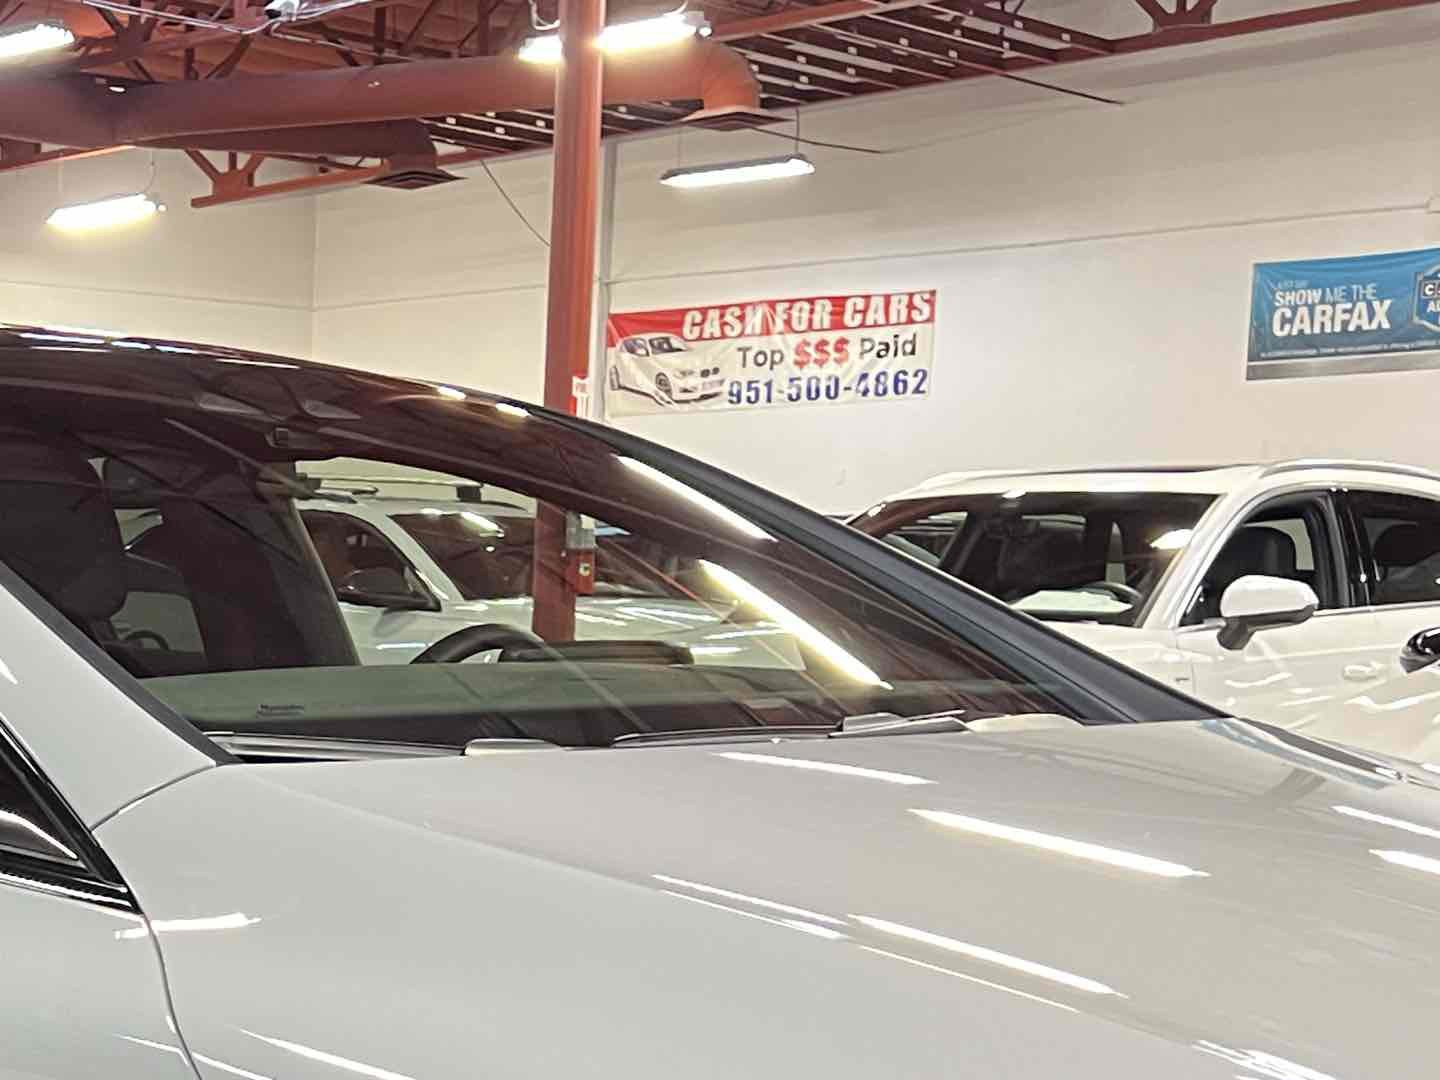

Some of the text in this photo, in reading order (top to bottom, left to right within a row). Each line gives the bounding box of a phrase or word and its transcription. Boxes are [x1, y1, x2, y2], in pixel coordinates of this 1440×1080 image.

[1273, 283, 1377, 307] SHOW ME THE
[682, 292, 932, 341] CASH FOR CARS
[1271, 299, 1393, 338] CARFAX
[737, 333, 918, 370] Top $$$ Paid
